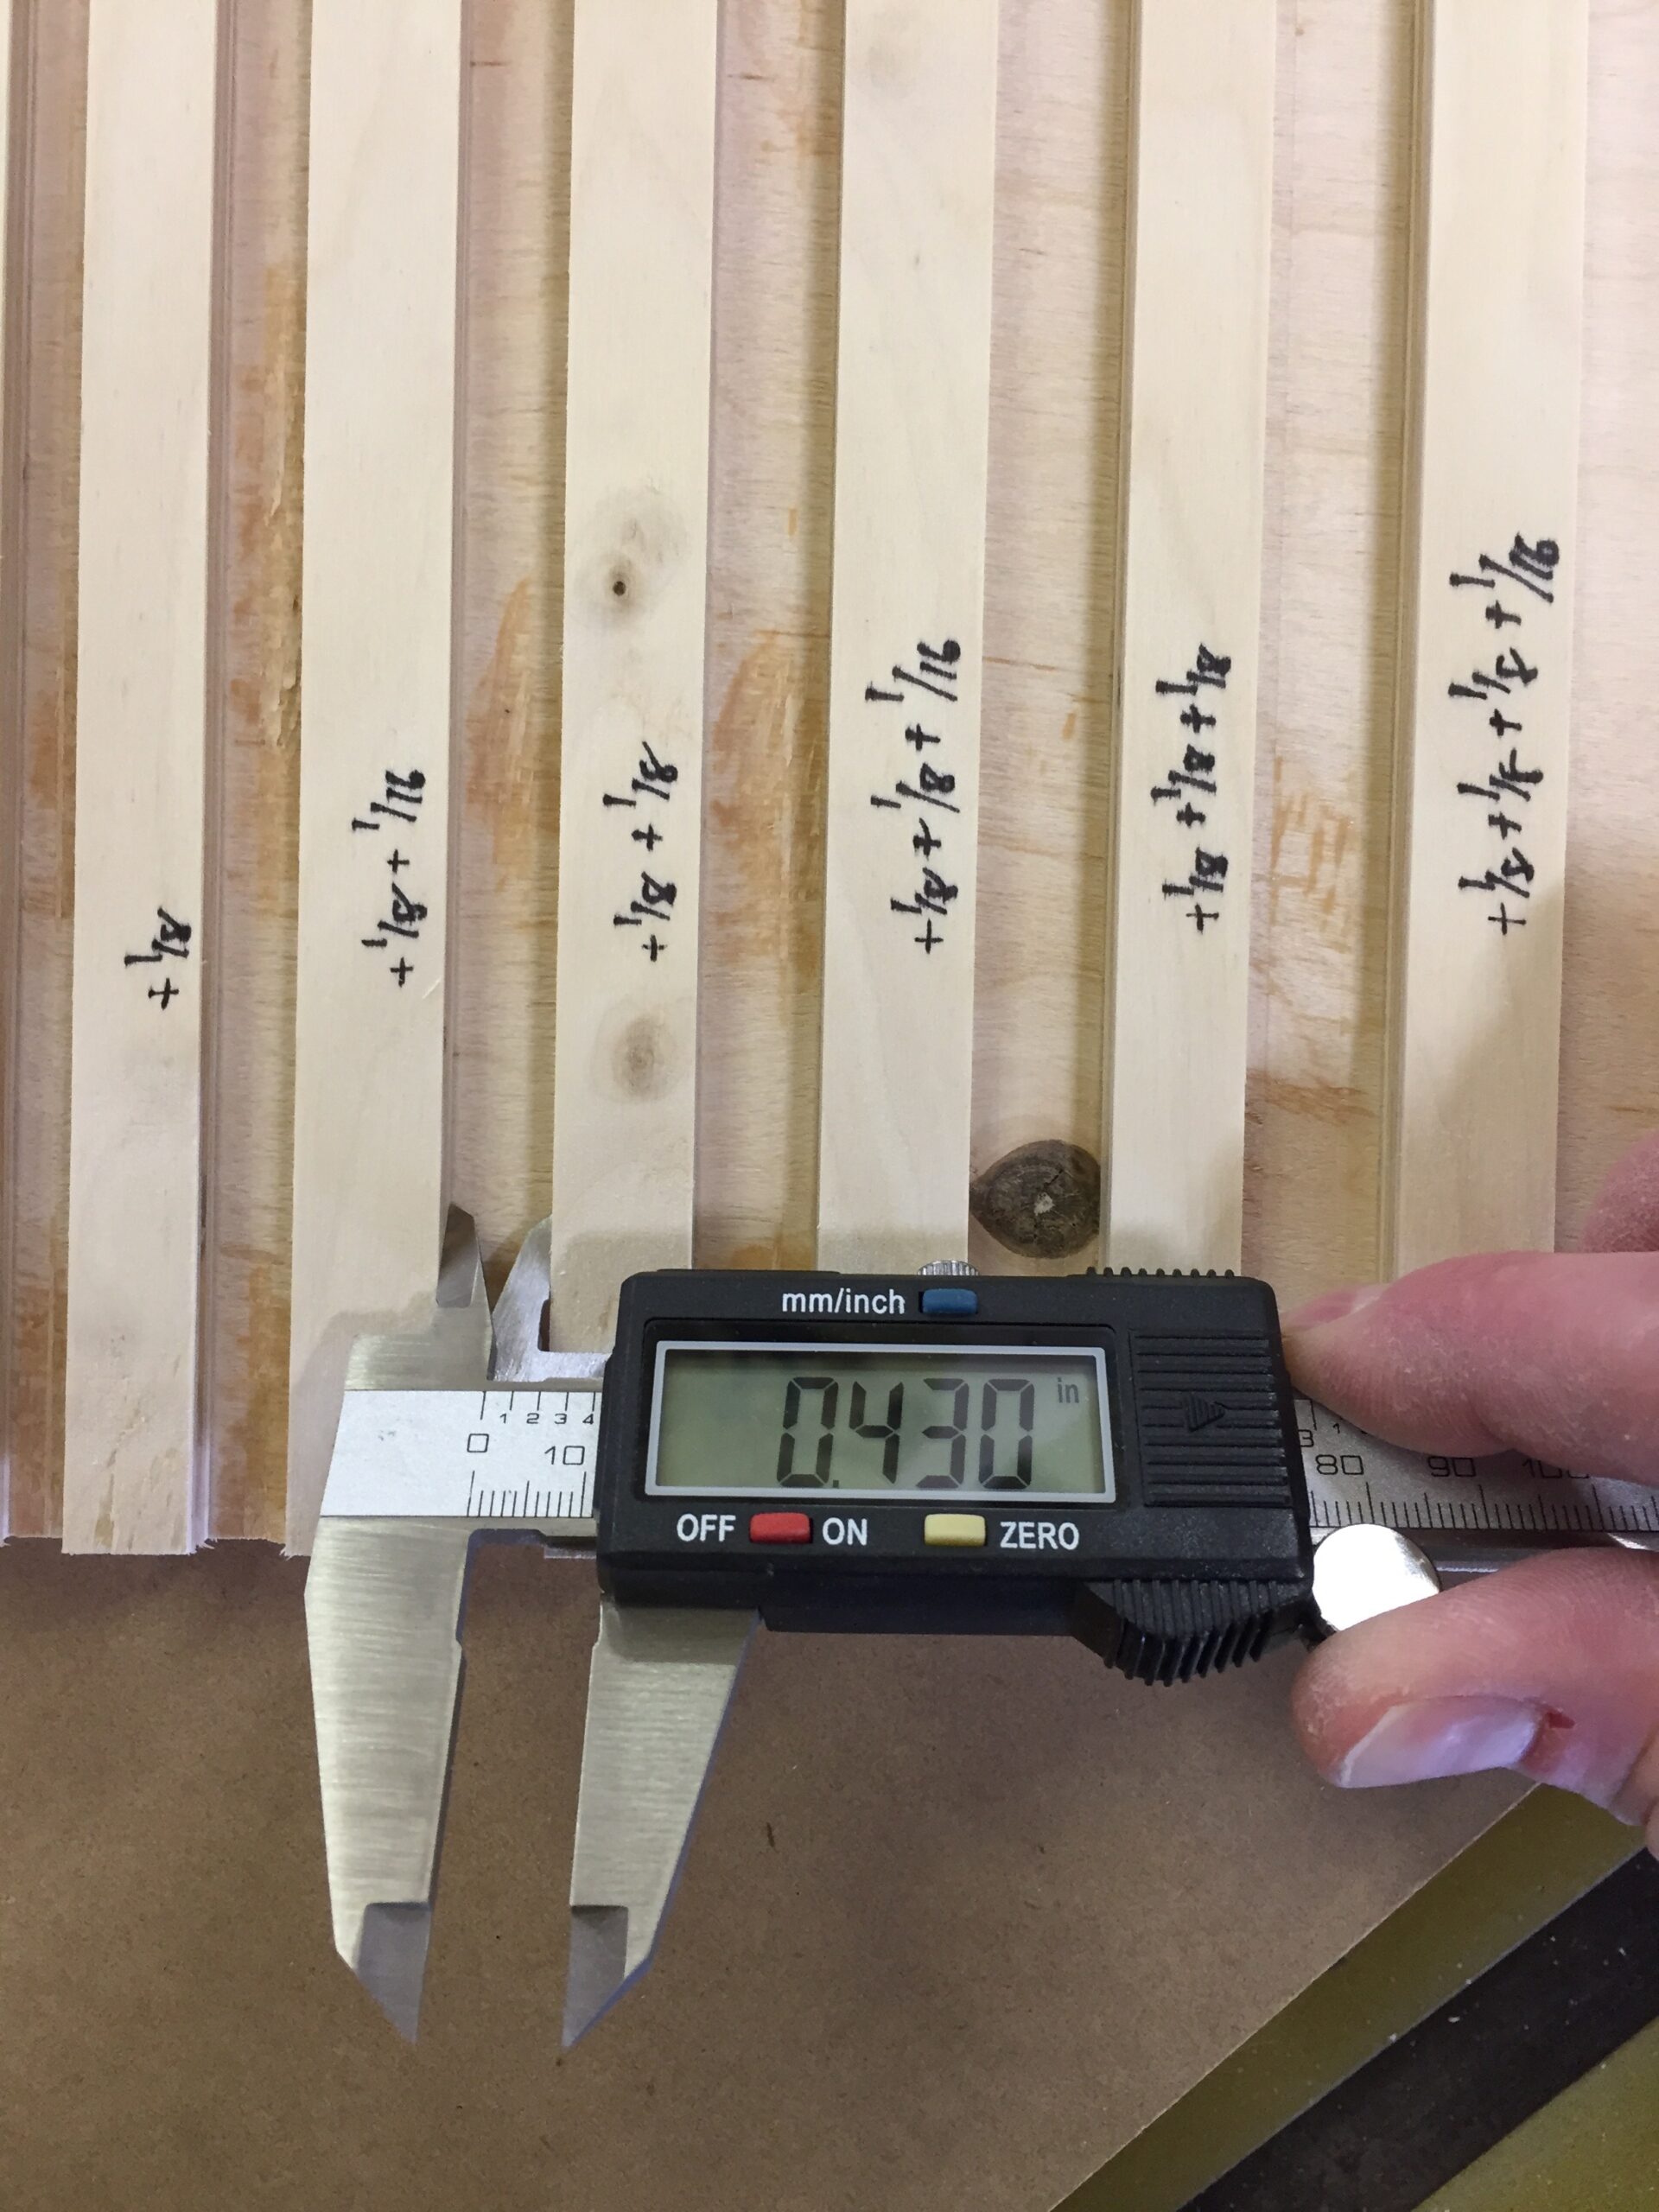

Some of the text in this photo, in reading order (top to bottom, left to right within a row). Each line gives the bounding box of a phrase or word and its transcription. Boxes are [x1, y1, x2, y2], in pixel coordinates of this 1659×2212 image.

[1448, 532, 1560, 605] 1/16
[865, 639, 961, 702] 1/16
[351, 769, 426, 832] 1/16
[781, 1288, 906, 1315] mm/inch
[499, 1413, 595, 1425] 1 2 3 4
[776, 1376, 1080, 1490] 0.430 in
[467, 1433, 586, 1465] 0 10
[1298, 1428, 1314, 1448] 3
[1315, 1453, 1364, 1476] 80
[1427, 1455, 1477, 1478] 90
[676, 1513, 737, 1542] OFF
[822, 1517, 868, 1546] ON
[1000, 1521, 1080, 1550] ZERO
